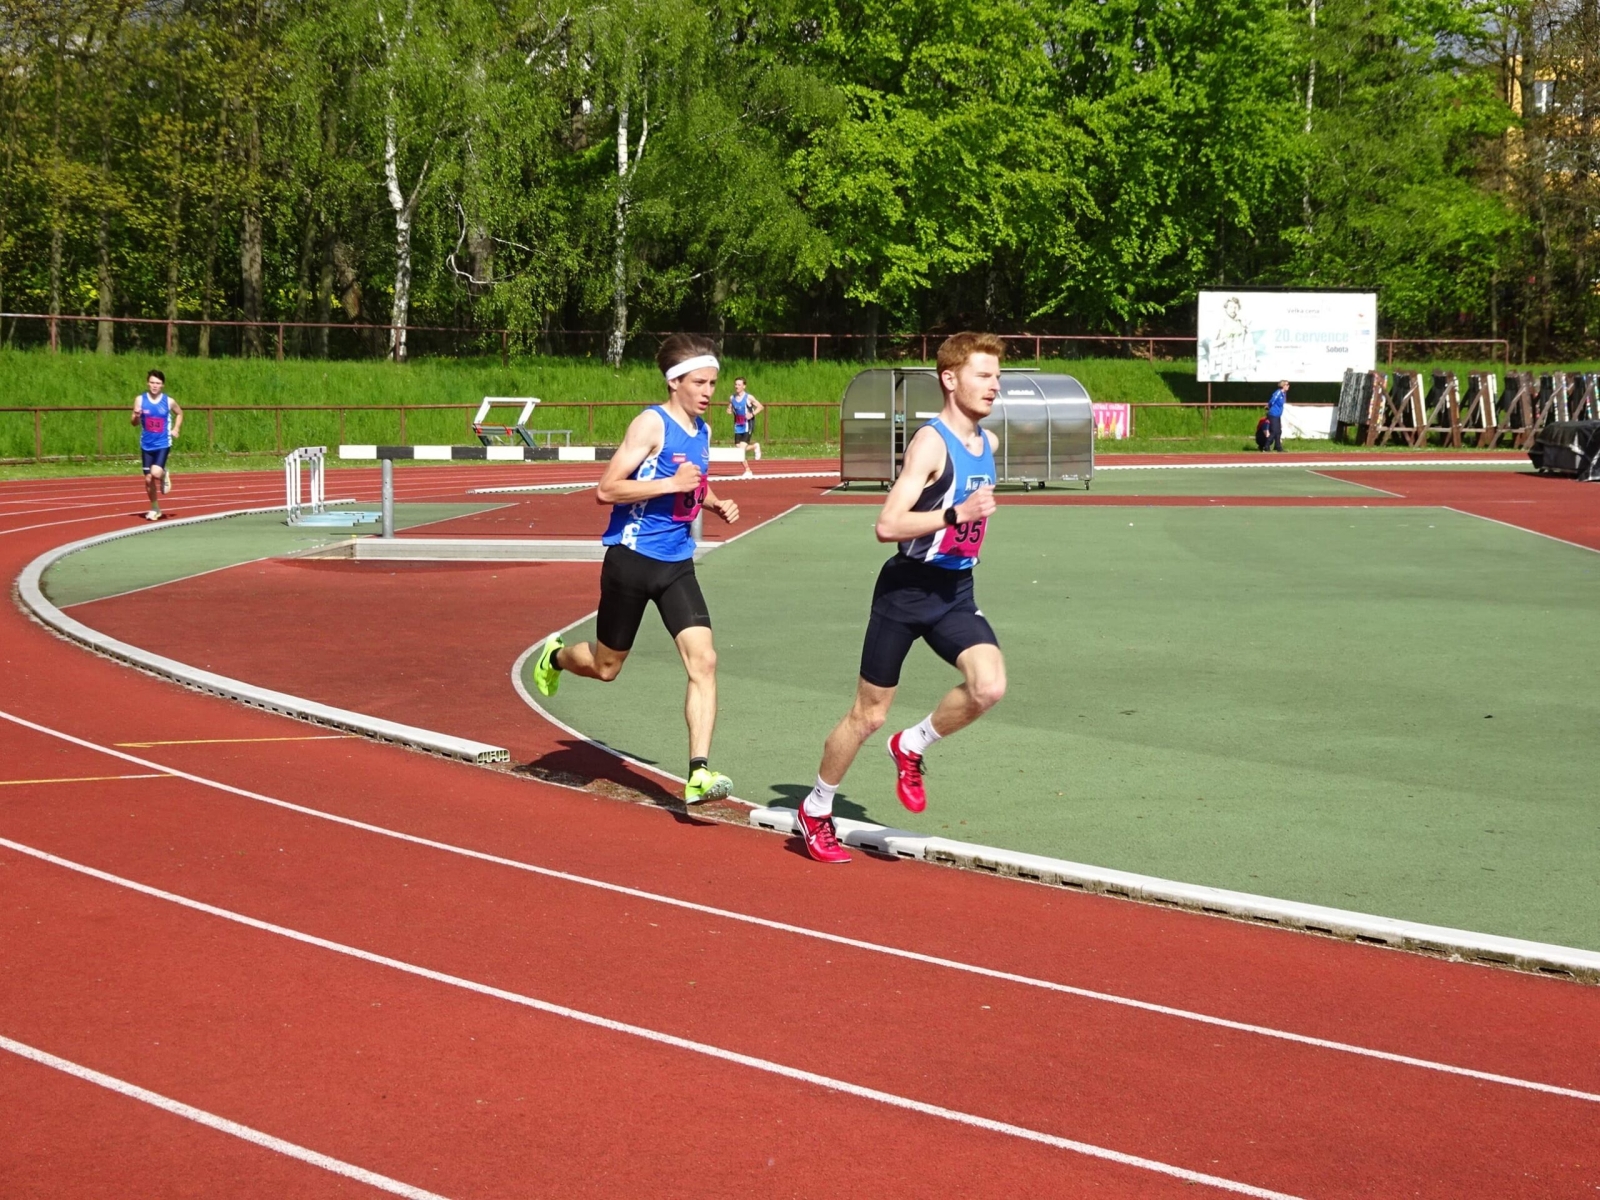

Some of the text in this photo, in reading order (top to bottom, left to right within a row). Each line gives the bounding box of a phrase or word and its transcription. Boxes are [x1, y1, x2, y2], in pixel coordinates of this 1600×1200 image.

[1275, 328, 1292, 342] 20.
[1326, 345, 1349, 353] Sobota
[684, 486, 705, 509] 84
[955, 521, 982, 543] 95
